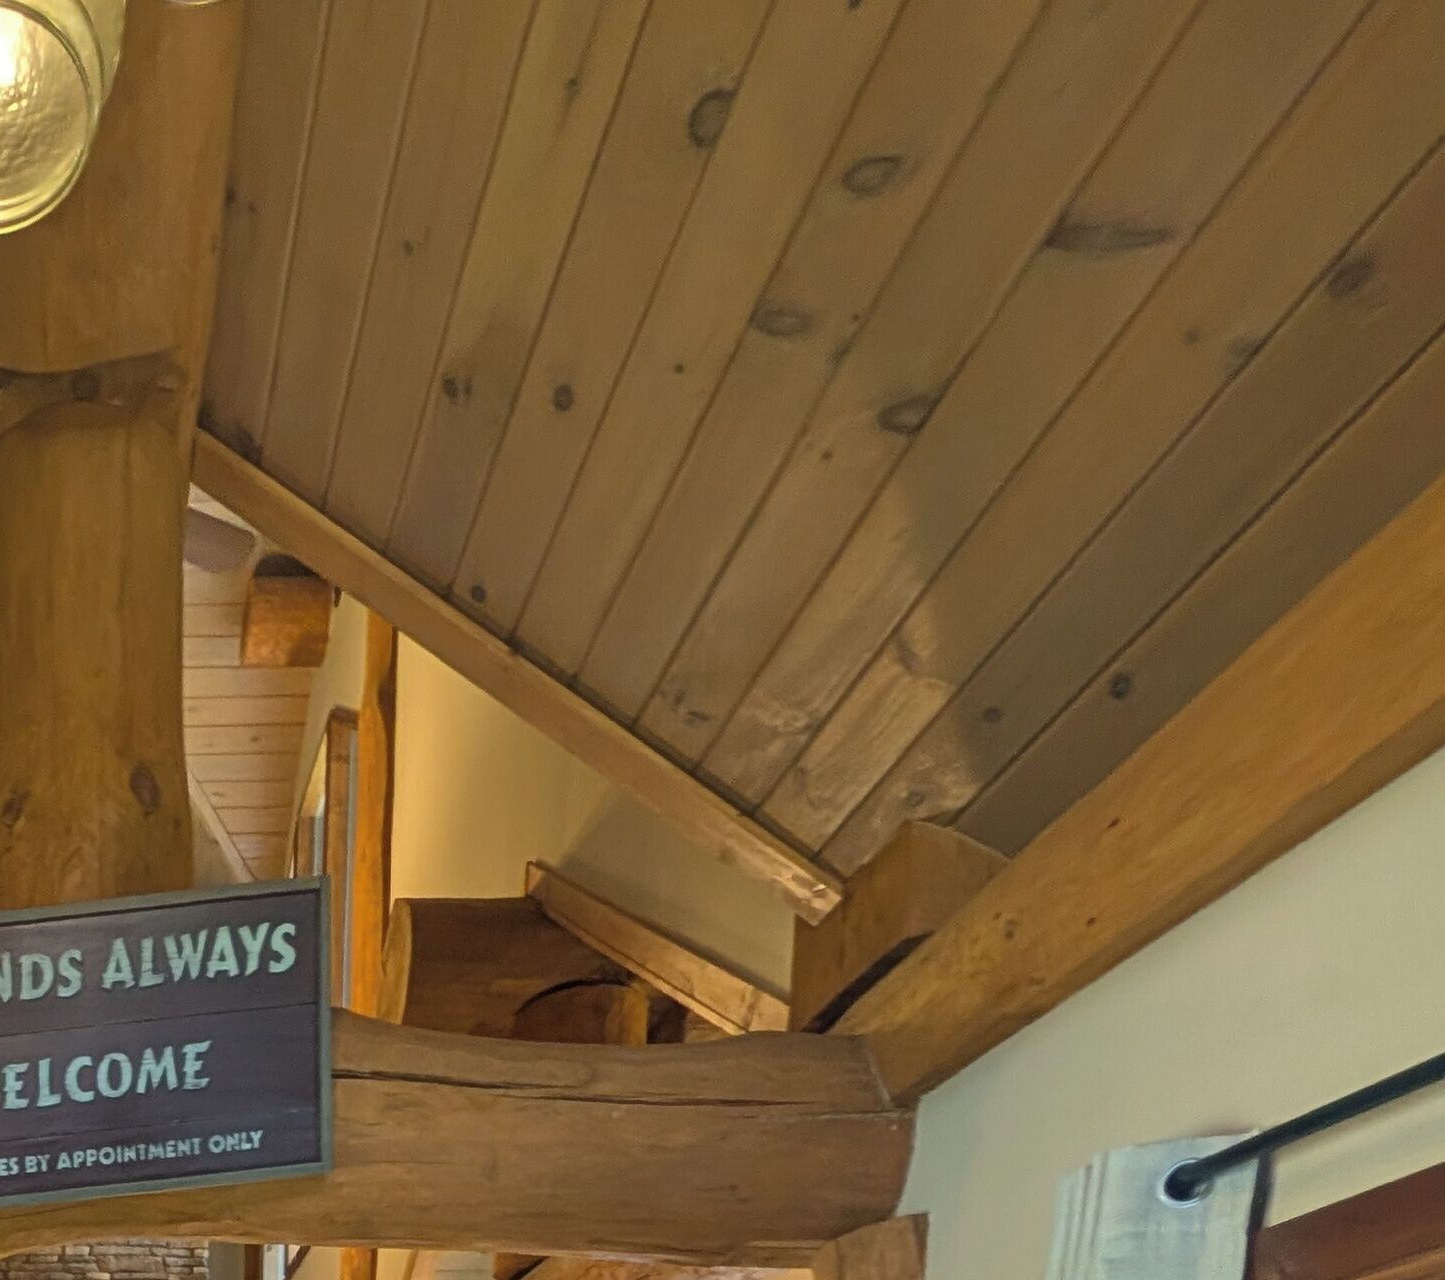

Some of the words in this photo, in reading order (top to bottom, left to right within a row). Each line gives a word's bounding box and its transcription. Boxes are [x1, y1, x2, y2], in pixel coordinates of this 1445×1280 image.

[101, 922, 297, 990] ALWAYS
[25, 1154, 49, 1174] BY
[56, 1137, 202, 1171] APPOINTMENT
[209, 1130, 263, 1154] ONLY
